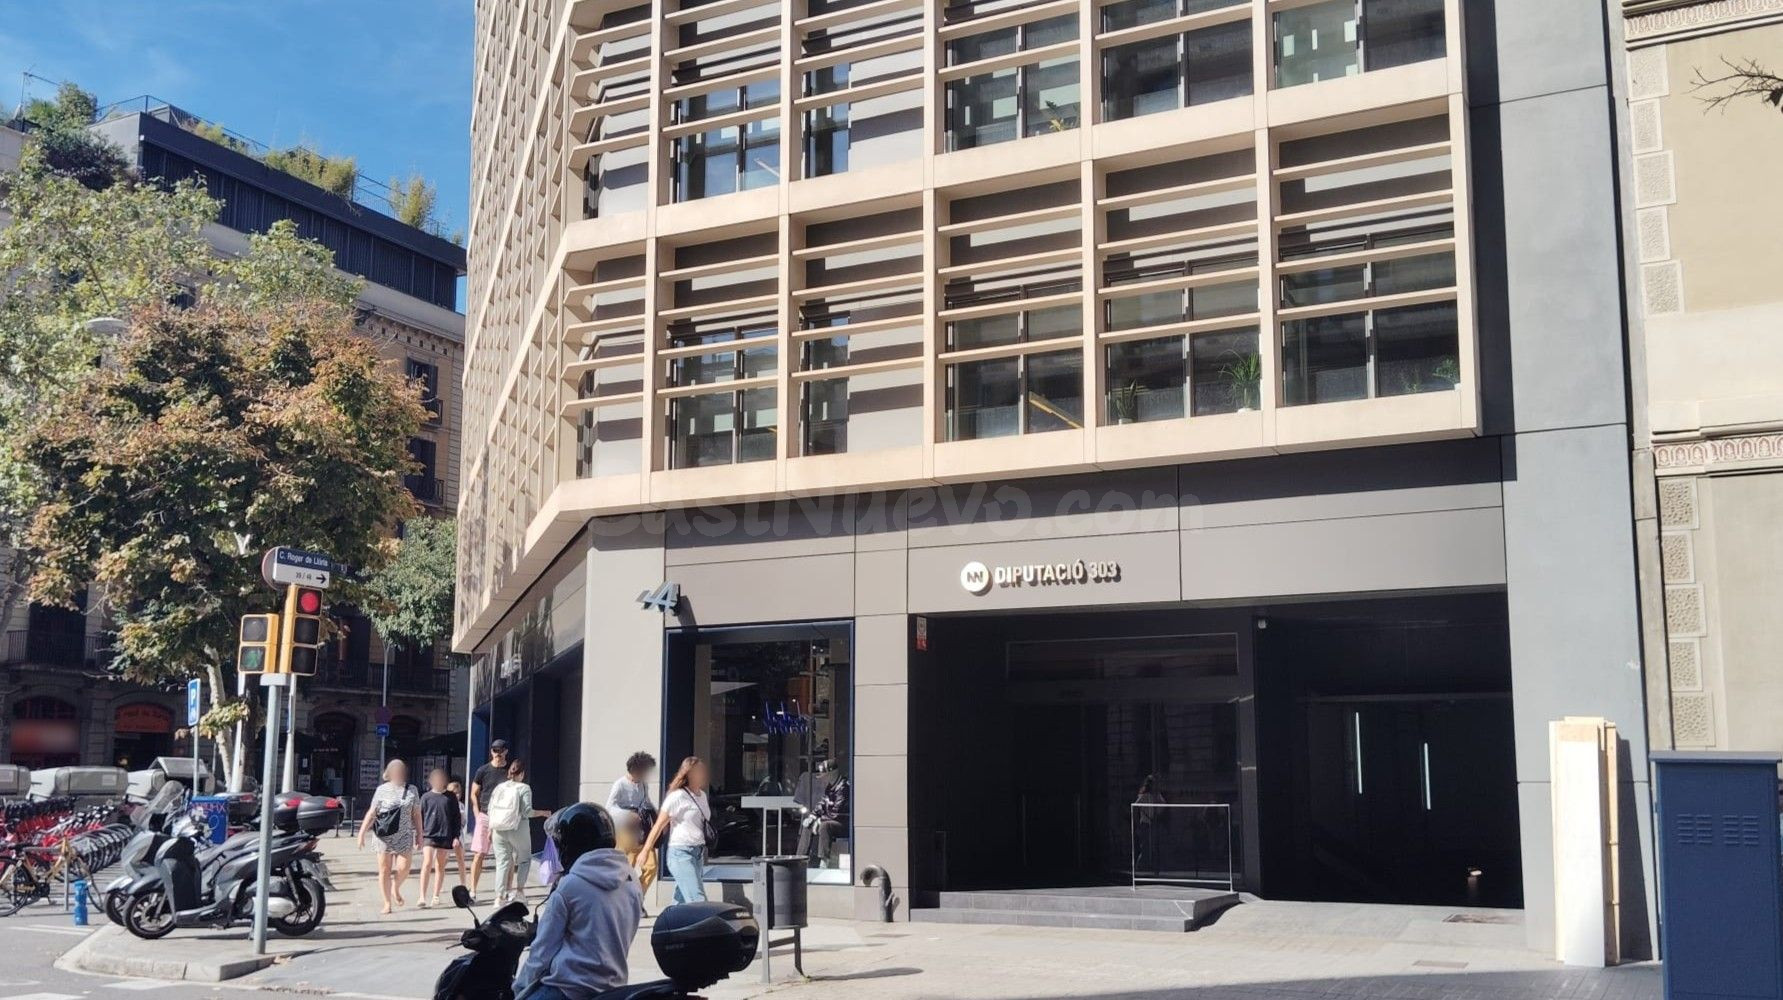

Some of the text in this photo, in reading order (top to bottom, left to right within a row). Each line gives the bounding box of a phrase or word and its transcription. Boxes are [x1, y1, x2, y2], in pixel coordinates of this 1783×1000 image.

[287, 552, 303, 563] Roger
[993, 559, 1084, 584] DIPUTACIÓ
[1088, 560, 1118, 579] 303
